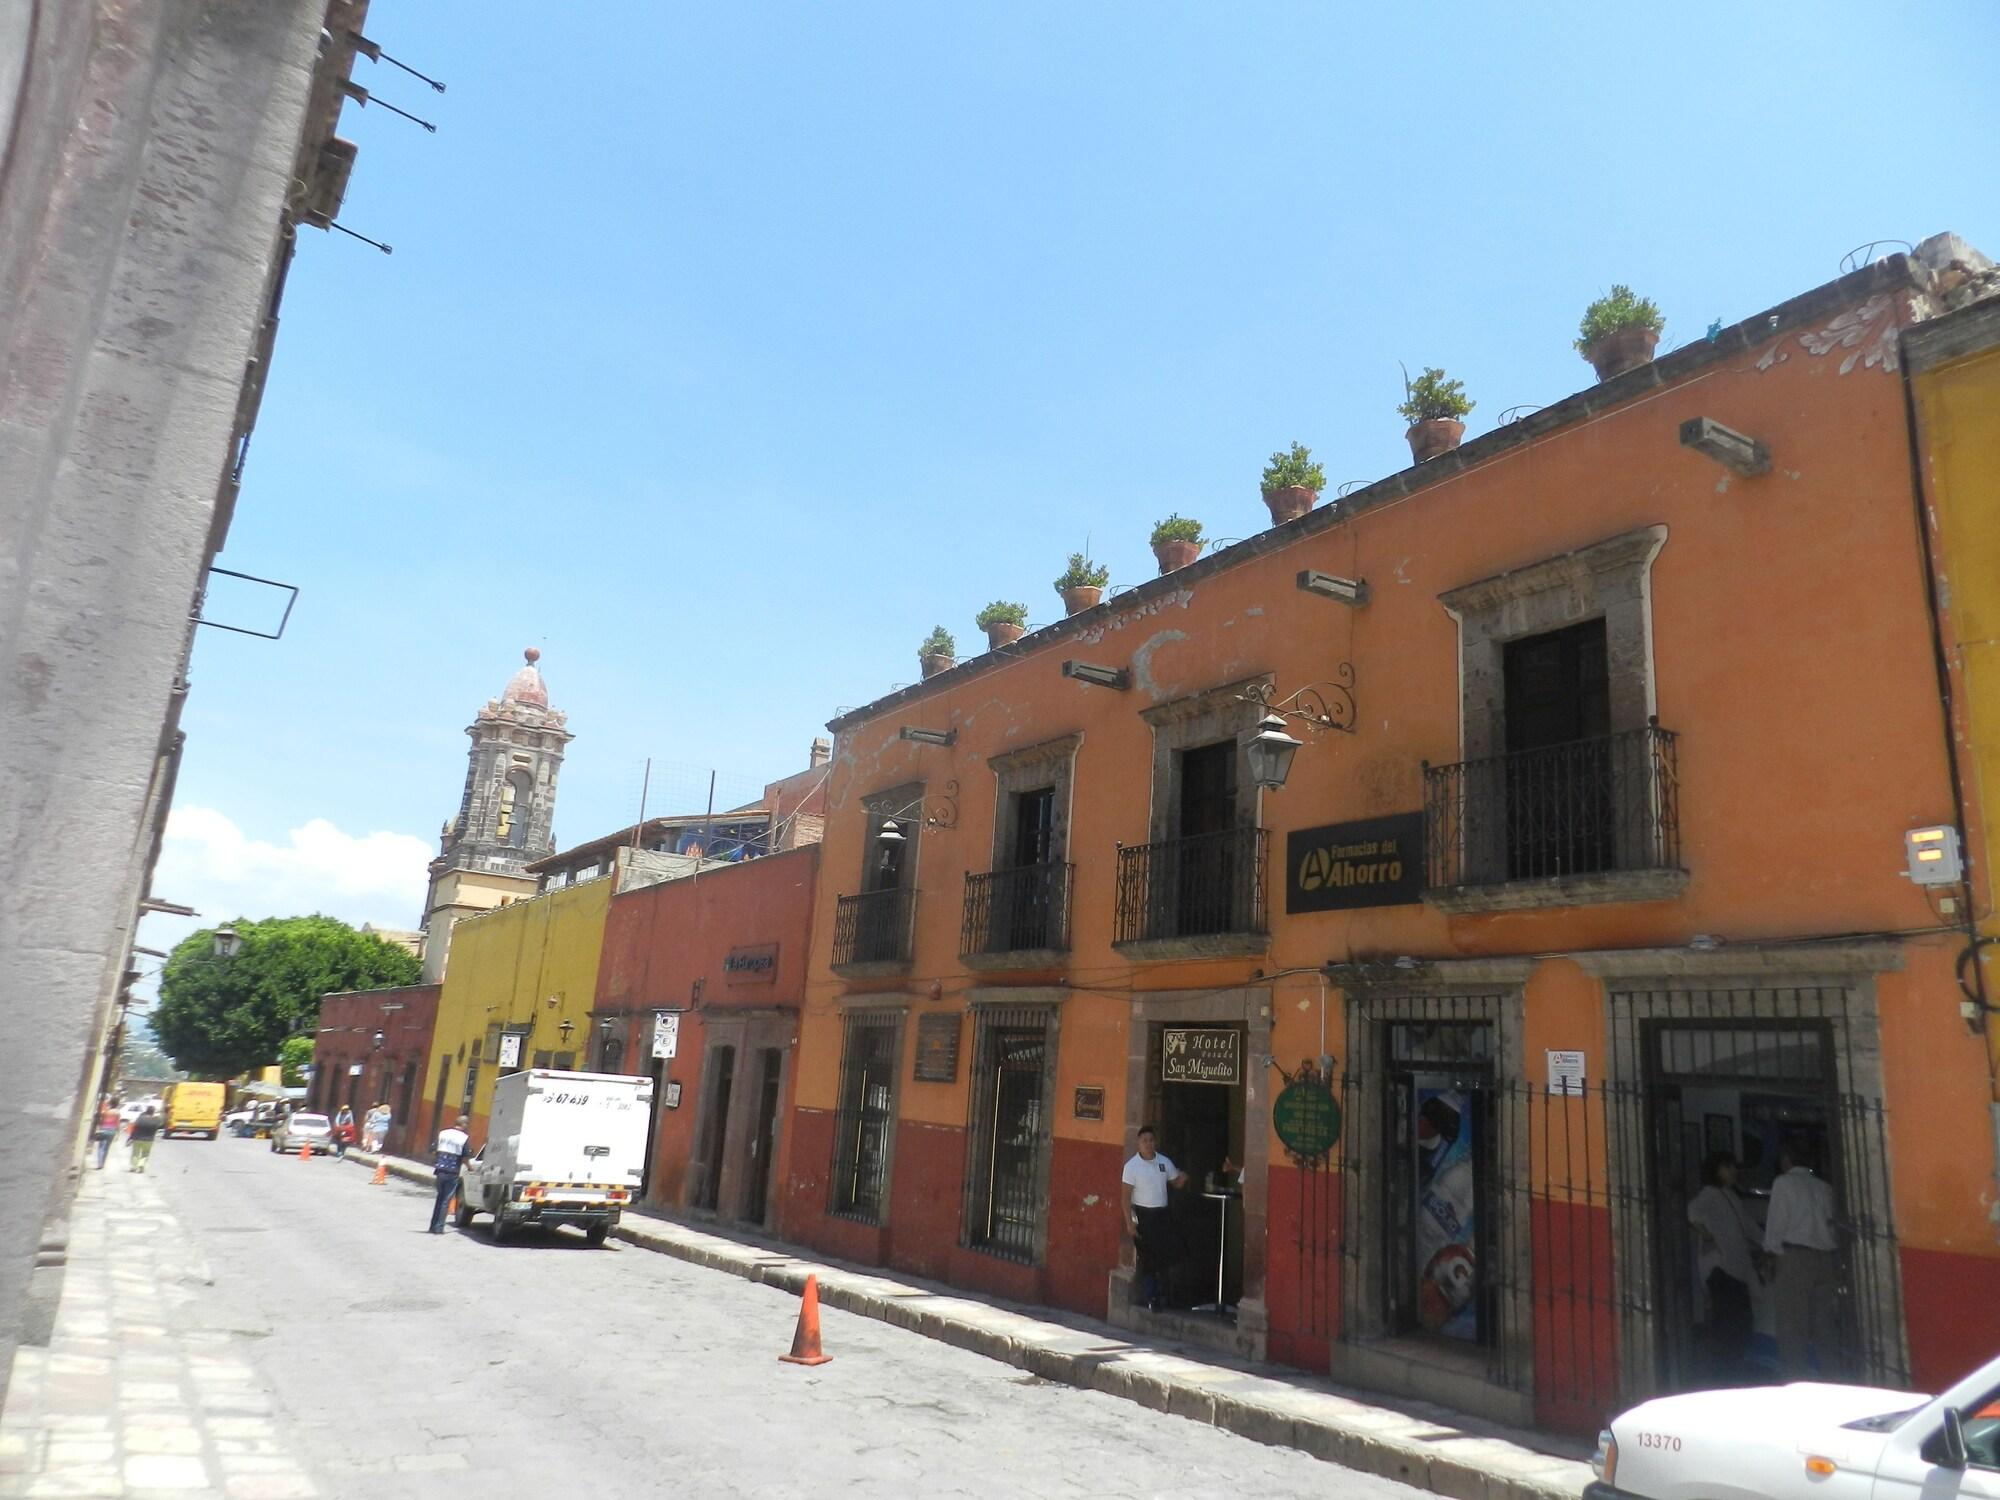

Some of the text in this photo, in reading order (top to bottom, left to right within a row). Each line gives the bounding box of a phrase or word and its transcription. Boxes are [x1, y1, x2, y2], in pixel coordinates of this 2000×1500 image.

[1326, 861, 1402, 887] Ahorro
[1192, 1033, 1235, 1049] Hotel
[1167, 1057, 1233, 1079] San Miguelito
[1636, 1432, 1682, 1452] 13370
